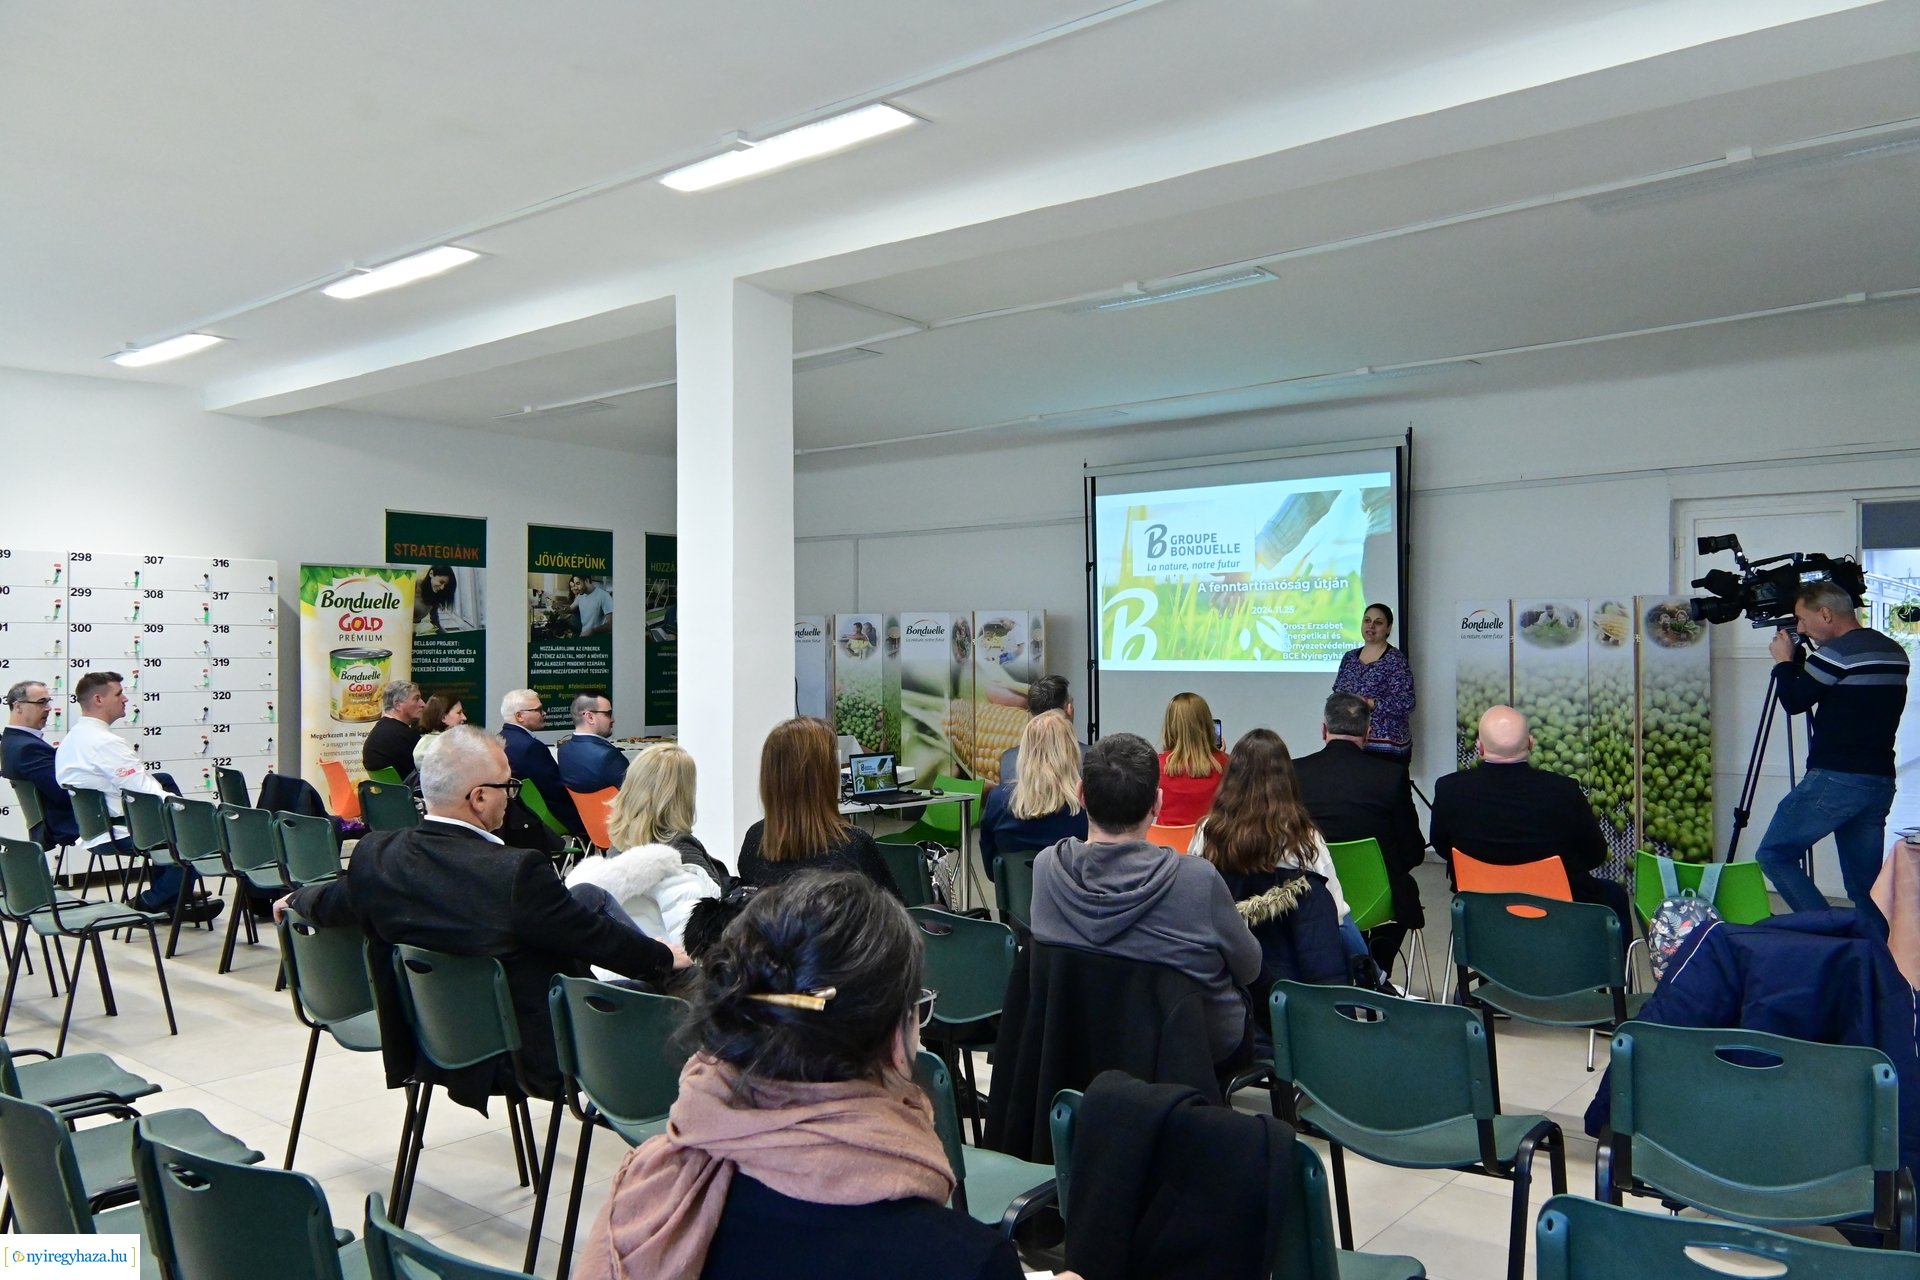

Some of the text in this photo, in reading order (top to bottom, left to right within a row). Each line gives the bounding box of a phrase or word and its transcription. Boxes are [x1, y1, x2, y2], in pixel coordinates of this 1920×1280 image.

[1170, 533, 1218, 545] GROUPE
[394, 542, 479, 560] STRATÉGIÁNK
[1170, 543, 1241, 557] BONDUELLE
[70, 552, 92, 562] 298
[144, 555, 164, 564] 307
[534, 551, 606, 569] JÖVŐKÉPÜNK
[212, 559, 230, 568] 316
[1147, 559, 1241, 572] La nature, notre futur
[1197, 577, 1349, 593] A fenntarthatóság útján
[70, 588, 92, 598] 299
[144, 590, 164, 599] 308
[212, 592, 229, 600] 317
[321, 589, 400, 613] Bonduelle
[338, 613, 383, 632] GOLD
[1283, 622, 1344, 630] Orosz Erzsébet
[1461, 617, 1504, 632] Bonduelle
[70, 624, 92, 633] 300
[144, 624, 164, 633] 309
[212, 625, 230, 633] 318
[906, 625, 945, 637] Bonduelle
[339, 633, 383, 642] PRÉMIUM
[795, 628, 821, 639] nduelle
[1331, 632, 1341, 640] és
[1301, 651, 1343, 661] Nyíregyhá
[70, 659, 90, 668] 301
[144, 658, 162, 667] 310
[212, 658, 230, 667] 319
[341, 670, 381, 683] Bonduelle
[348, 683, 373, 692] GOLD
[144, 693, 160, 701] 311
[212, 691, 231, 700] 320
[144, 727, 162, 736] 312
[212, 724, 230, 733] 321
[144, 762, 161, 770] 313
[213, 757, 232, 766] 322
